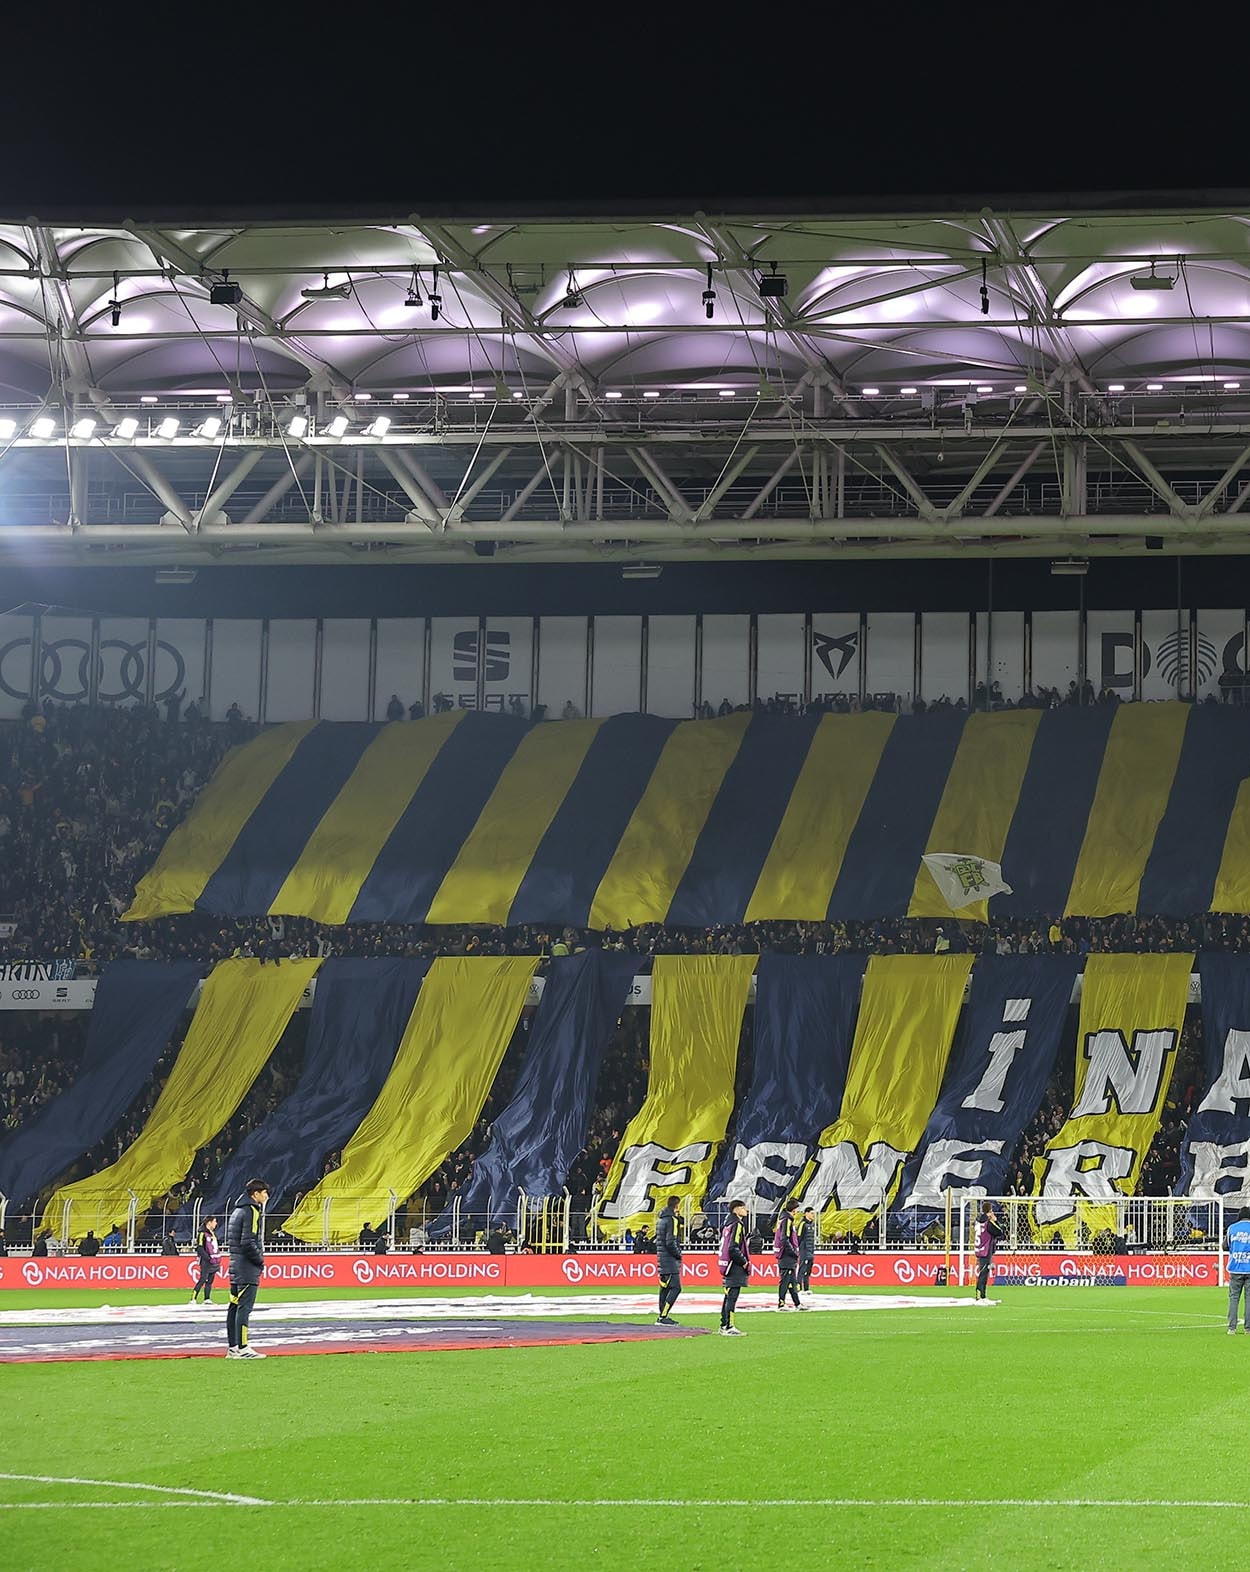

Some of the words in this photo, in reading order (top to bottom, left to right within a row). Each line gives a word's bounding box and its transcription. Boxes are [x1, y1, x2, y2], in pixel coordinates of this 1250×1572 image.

[45, 1266, 87, 1280] NATA
[375, 1264, 418, 1278] NATA
[585, 1263, 627, 1278] NATA
[1082, 1264, 1125, 1278] NATA
[1024, 1275, 1096, 1287] Chobani
